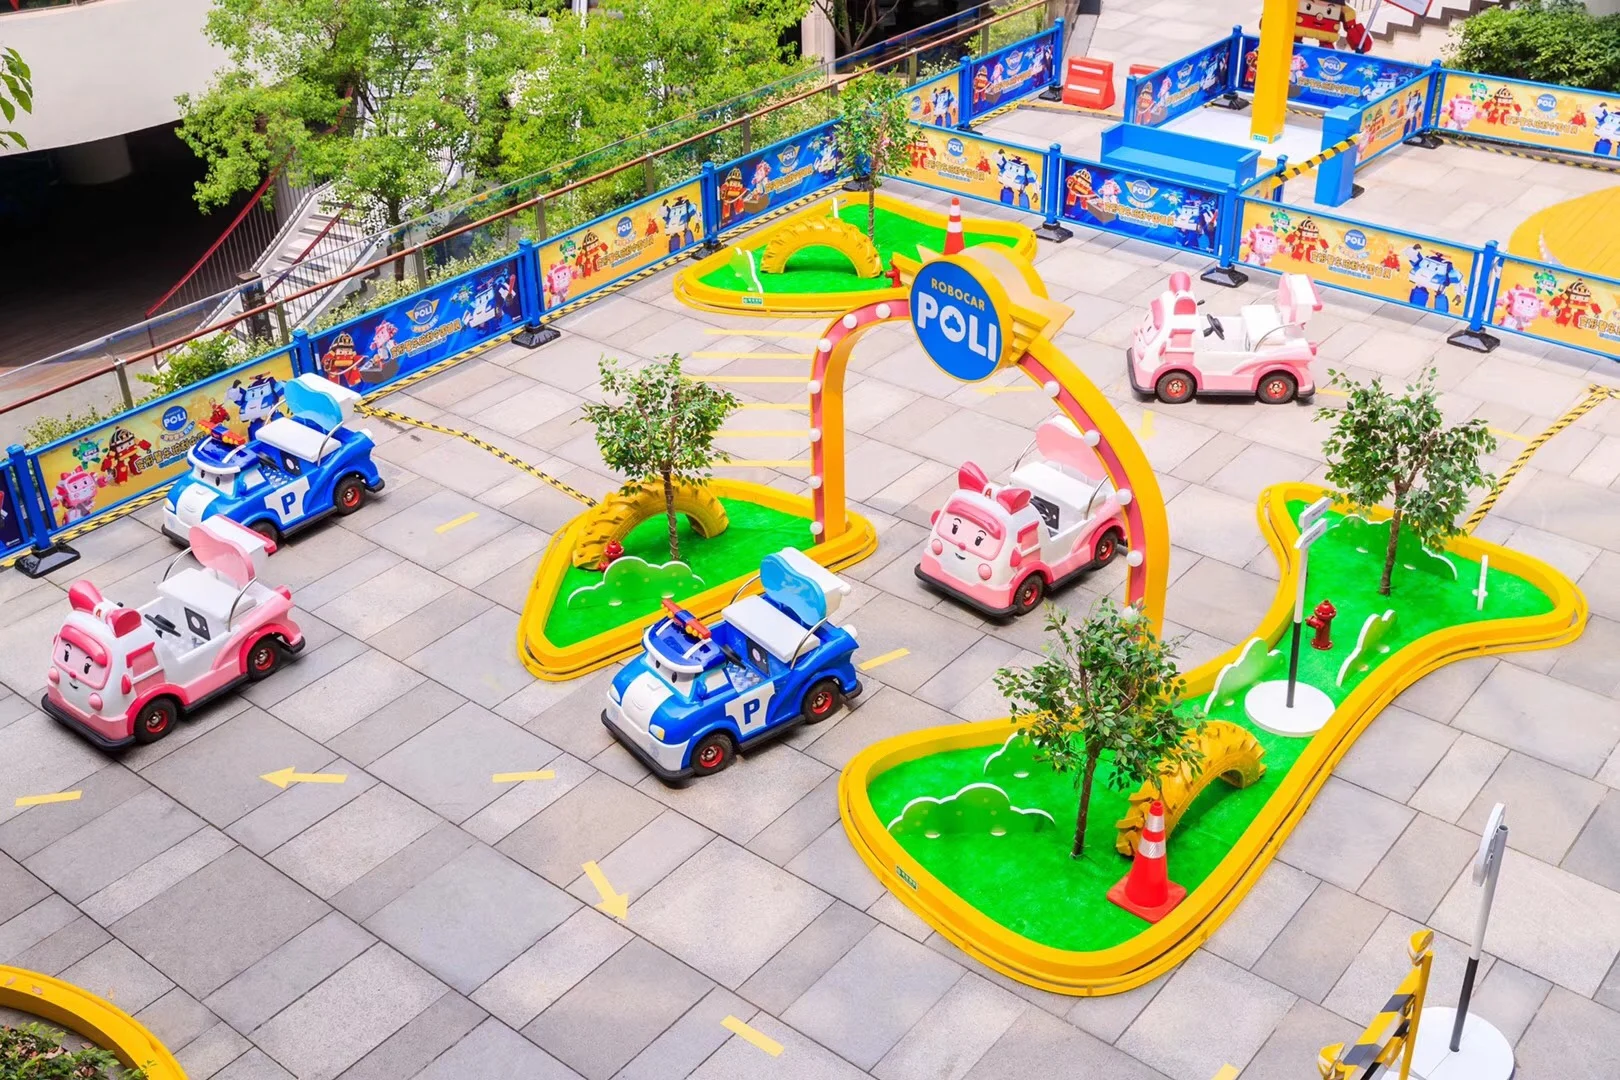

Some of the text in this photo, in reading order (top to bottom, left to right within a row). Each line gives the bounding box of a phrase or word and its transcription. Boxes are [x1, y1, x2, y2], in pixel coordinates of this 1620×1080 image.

[1536, 98, 1556, 108] POLI
[947, 142, 964, 153] POLI
[1132, 185, 1151, 197] POLI
[617, 221, 633, 235] POLI
[1344, 234, 1367, 247] POLI
[931, 278, 985, 311] ROBOCAR
[414, 305, 433, 320] POLI
[917, 291, 997, 363] POLI
[163, 411, 187, 428] POLI
[281, 491, 296, 516] P
[743, 698, 760, 725] P
